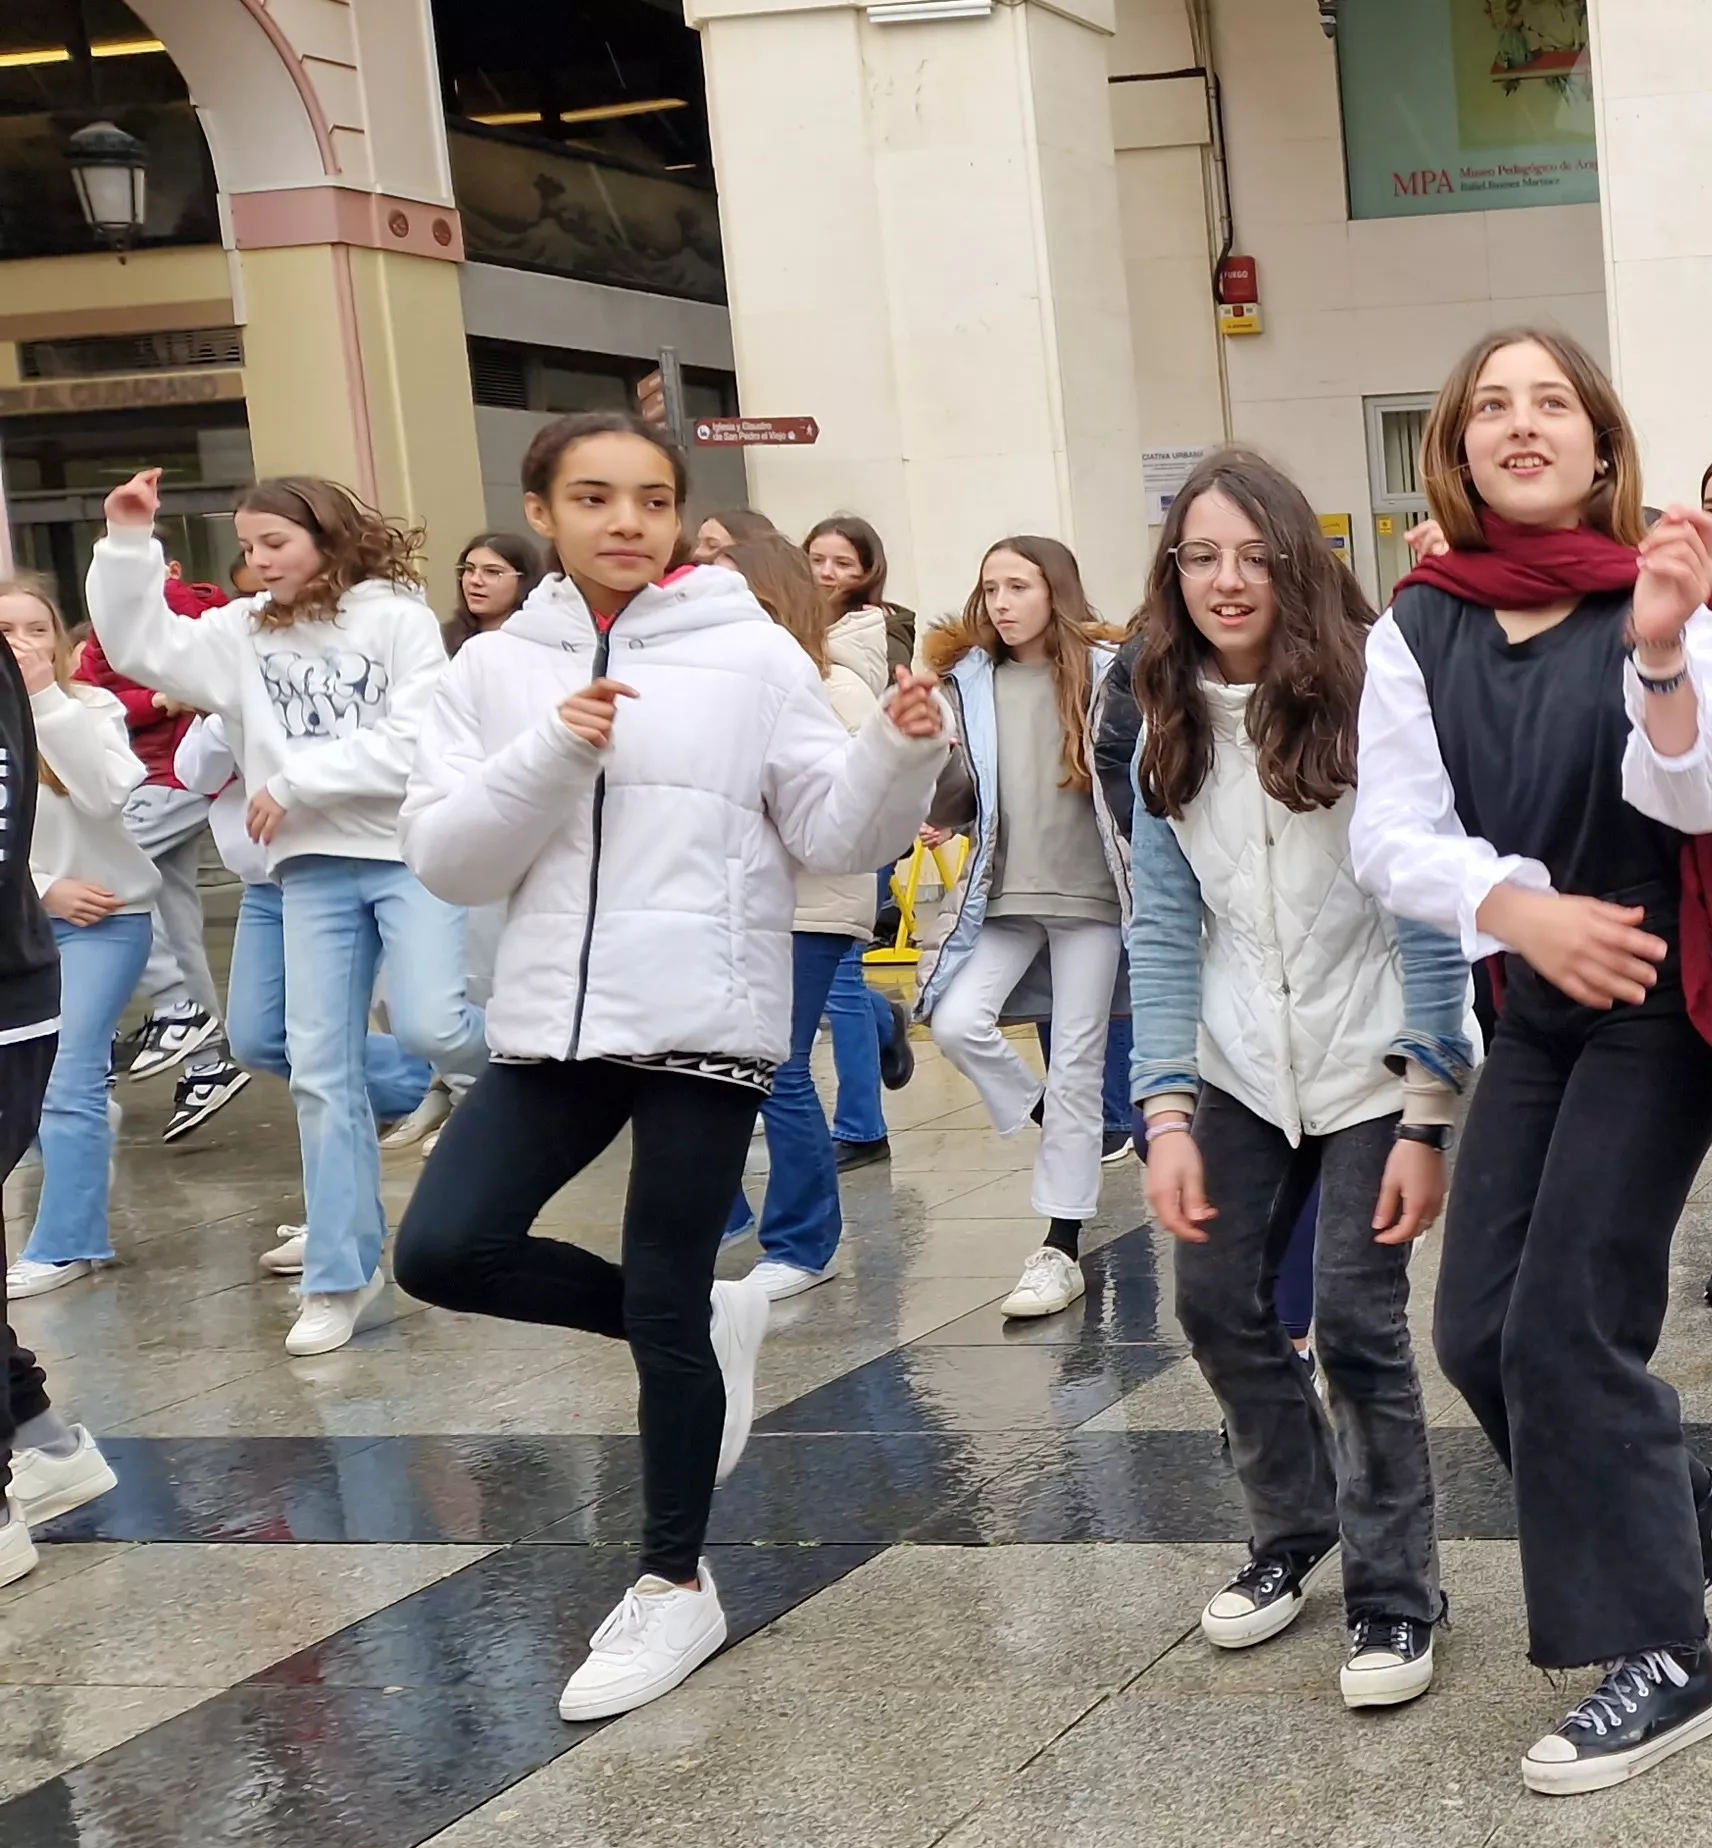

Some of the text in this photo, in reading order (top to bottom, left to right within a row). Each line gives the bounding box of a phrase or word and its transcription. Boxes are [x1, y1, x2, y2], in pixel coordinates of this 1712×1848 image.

[1459, 167, 1495, 178] Museo
[1393, 168, 1455, 197] MPA
[723, 431, 738, 441] San
[739, 431, 760, 441] Pedro
